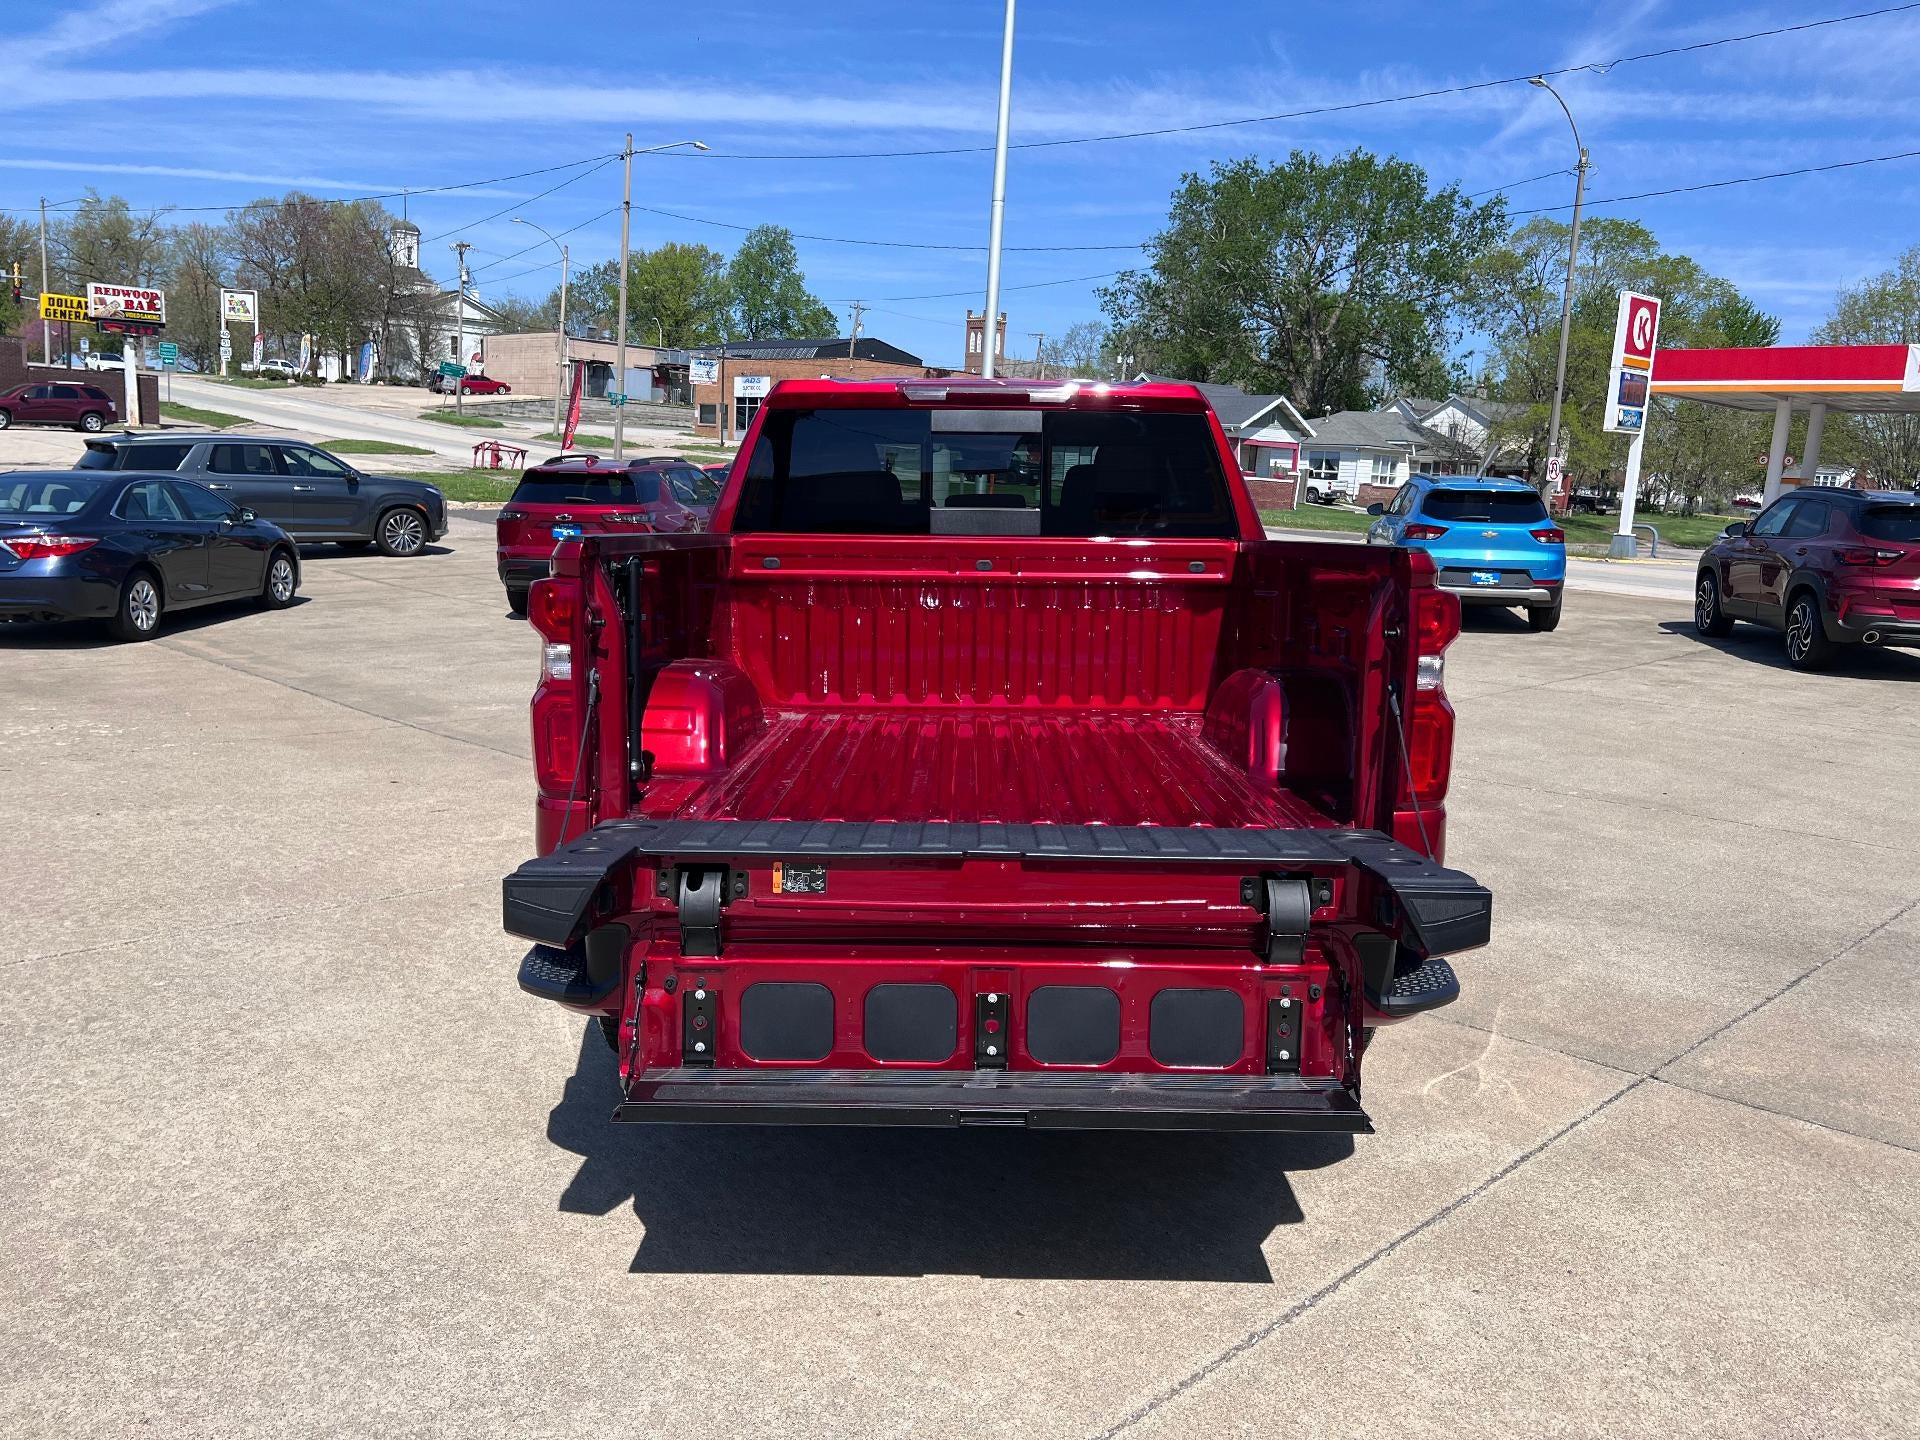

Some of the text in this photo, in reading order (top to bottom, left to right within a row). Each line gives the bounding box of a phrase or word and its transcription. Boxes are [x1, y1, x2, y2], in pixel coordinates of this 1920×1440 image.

[94, 286, 160, 301] REDWOOD
[124, 300, 157, 311] BAR
[44, 308, 89, 320] GENERA
[1637, 315, 1649, 346] K
